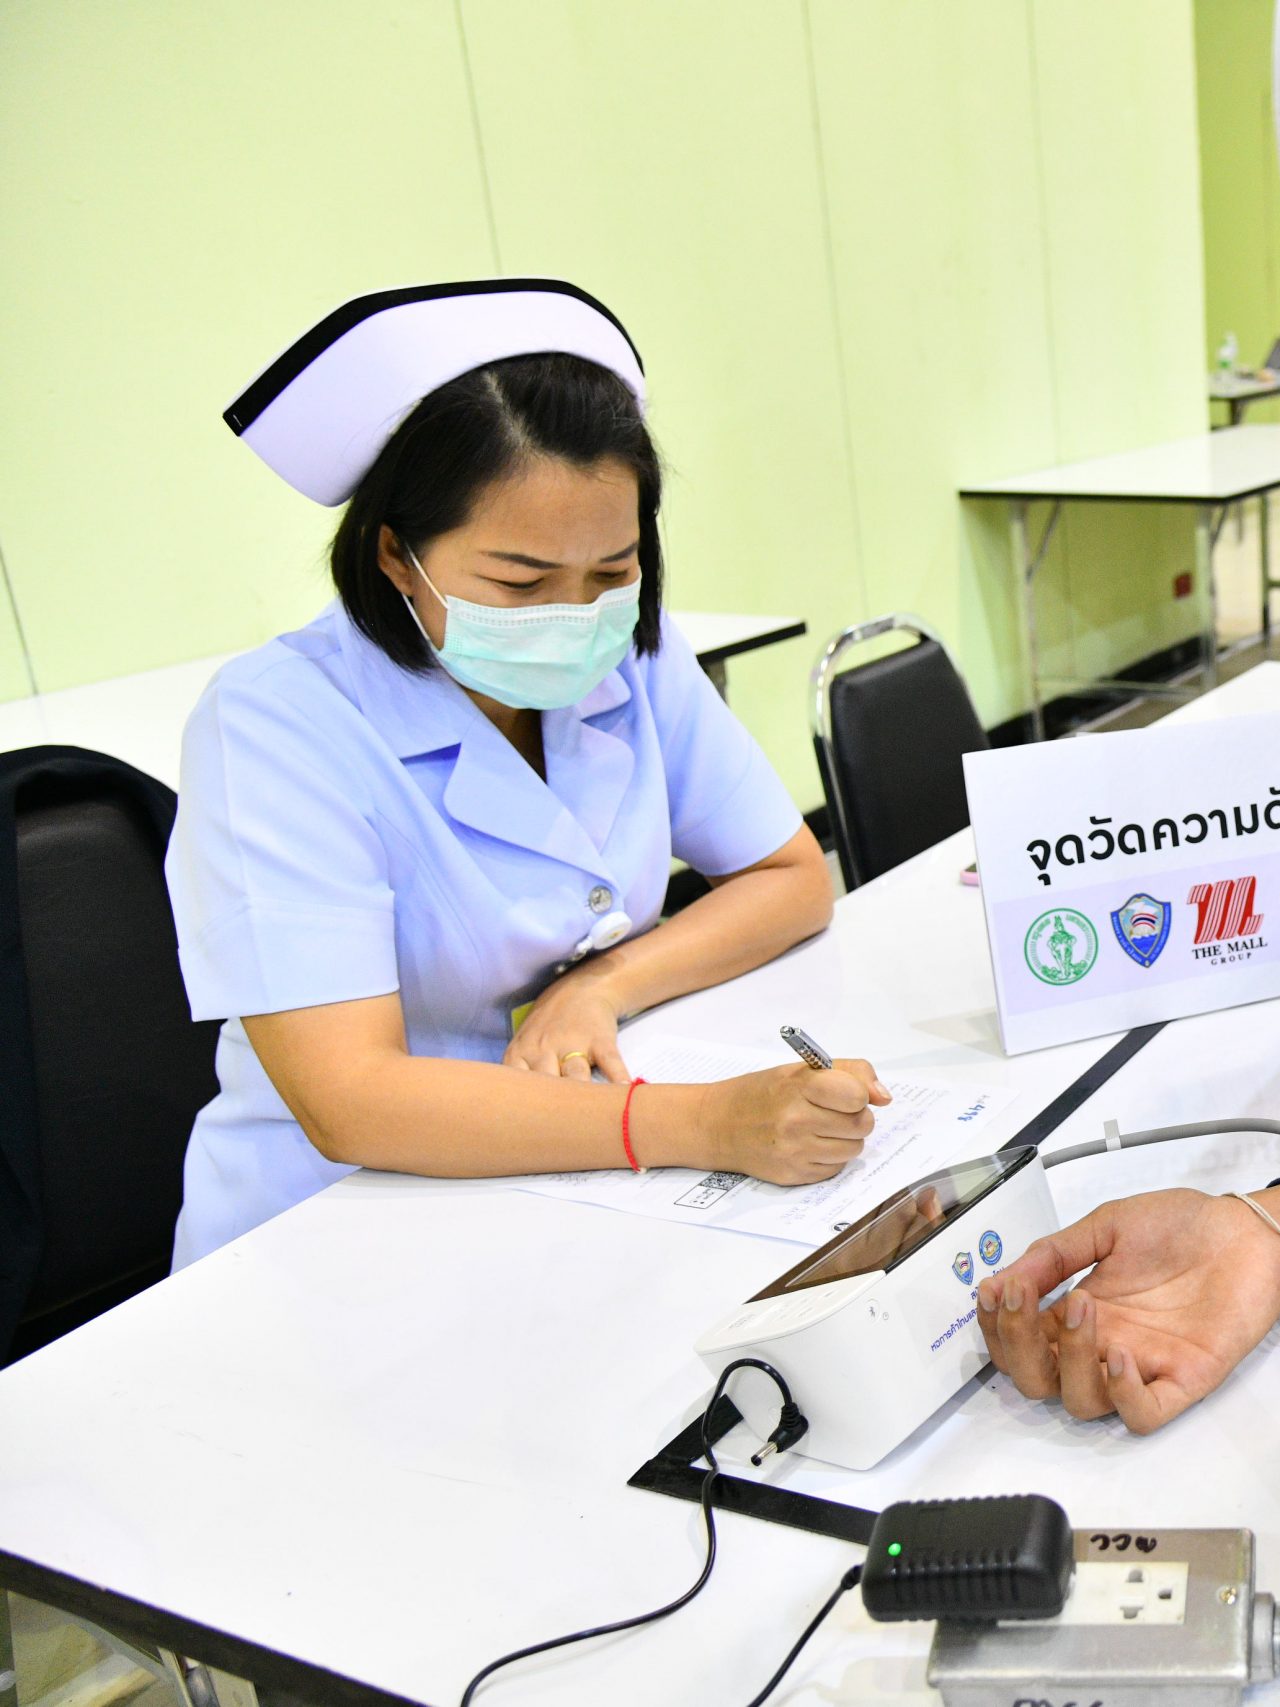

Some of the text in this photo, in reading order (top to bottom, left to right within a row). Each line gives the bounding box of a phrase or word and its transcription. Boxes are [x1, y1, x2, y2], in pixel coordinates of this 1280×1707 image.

[1191, 937, 1268, 960] THE MALL
[1210, 952, 1253, 966] GROUP
